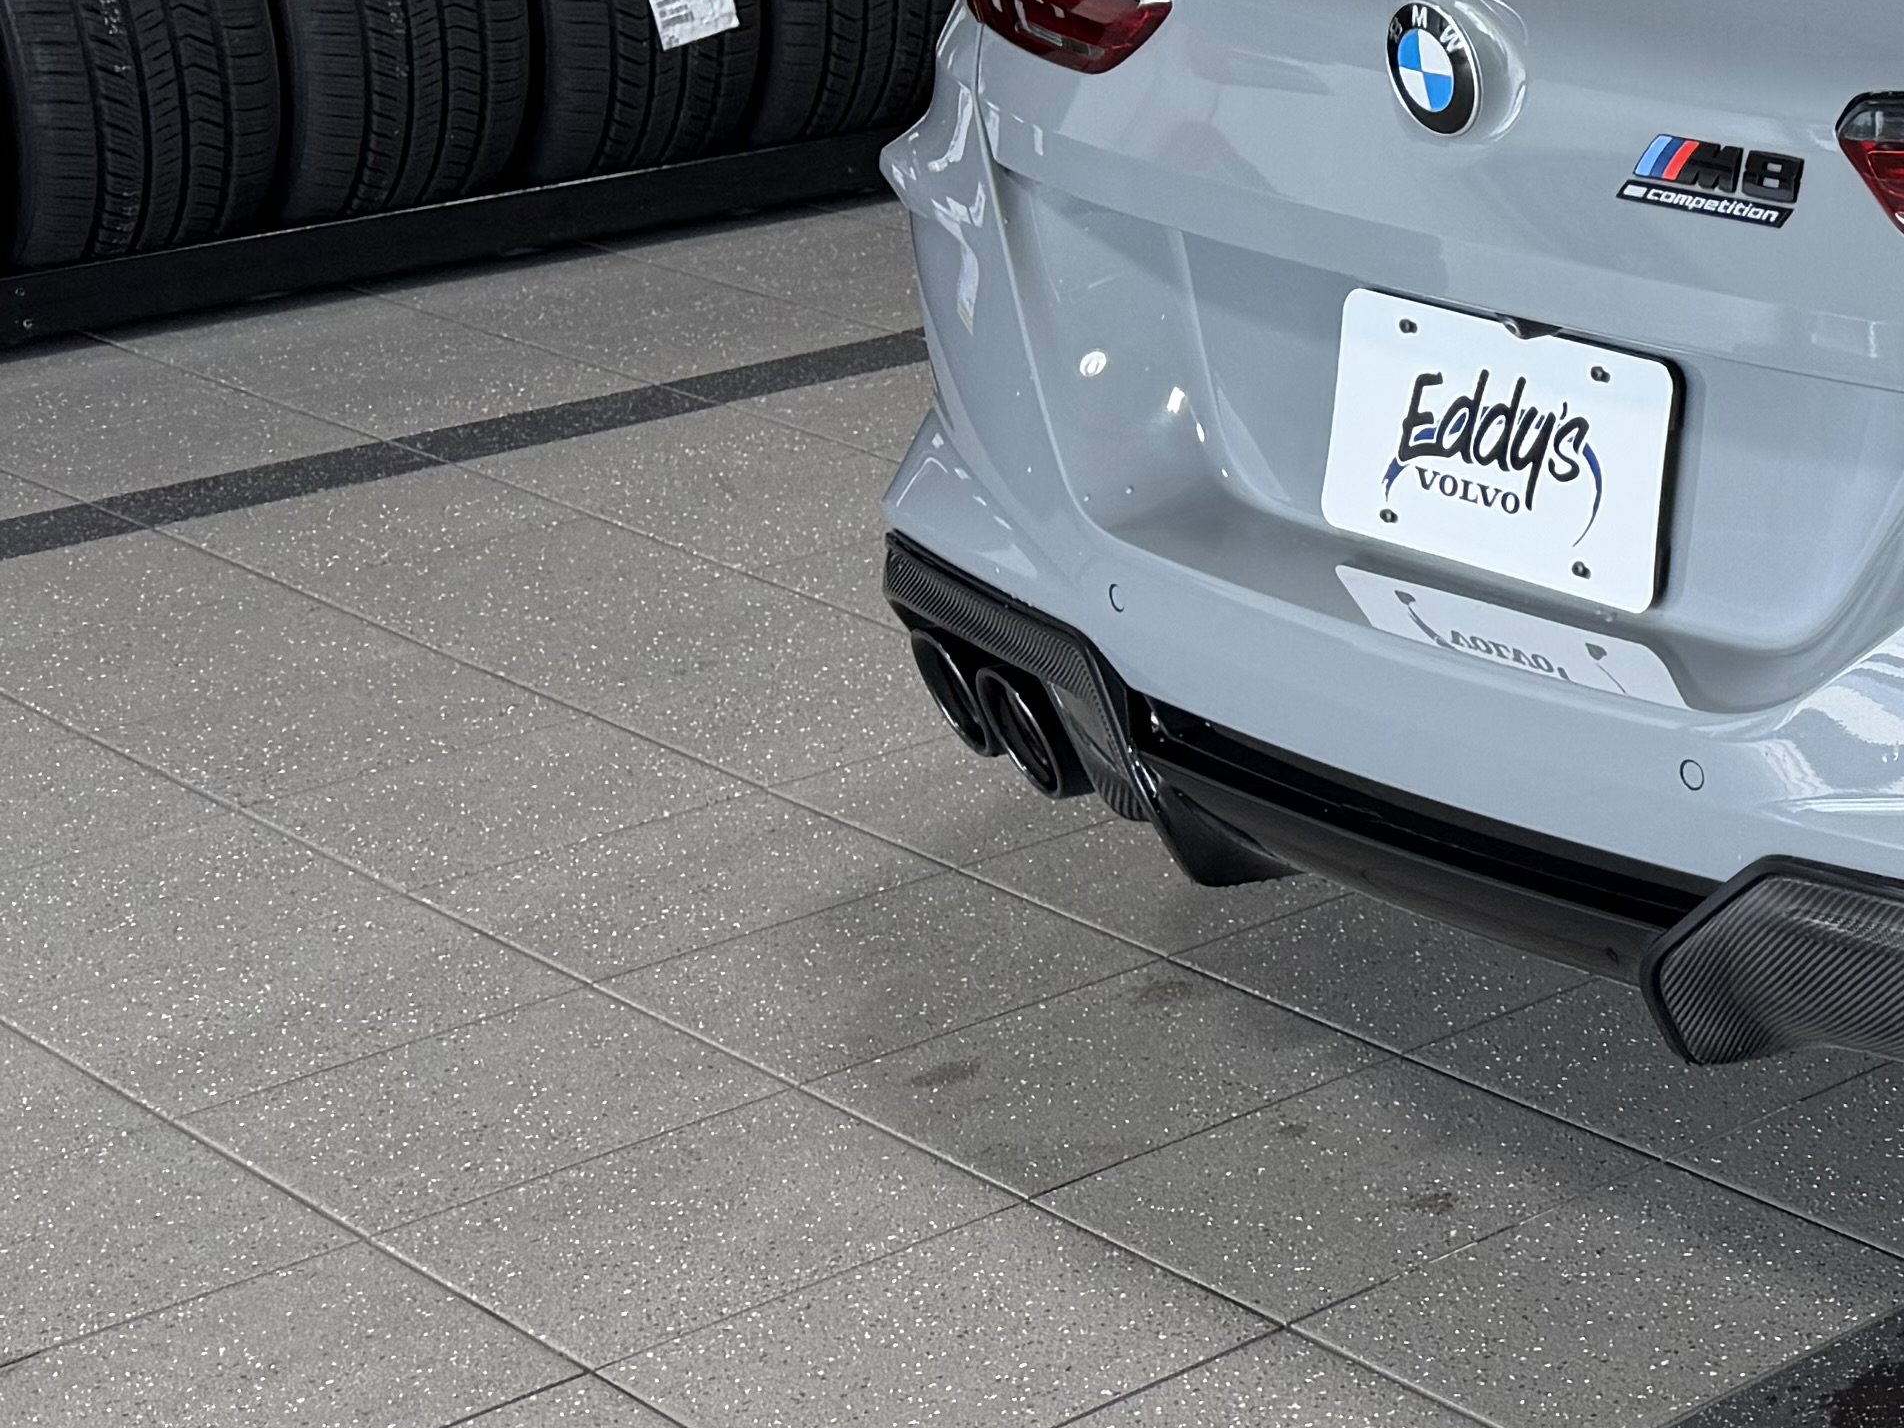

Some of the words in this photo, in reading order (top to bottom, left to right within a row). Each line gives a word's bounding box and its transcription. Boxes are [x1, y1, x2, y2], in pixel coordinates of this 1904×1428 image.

[1389, 4, 1464, 53] BMW
[1646, 188, 1780, 222] competition
[1398, 369, 1590, 511] Eddy's
[1414, 466, 1521, 515] VOLVO
